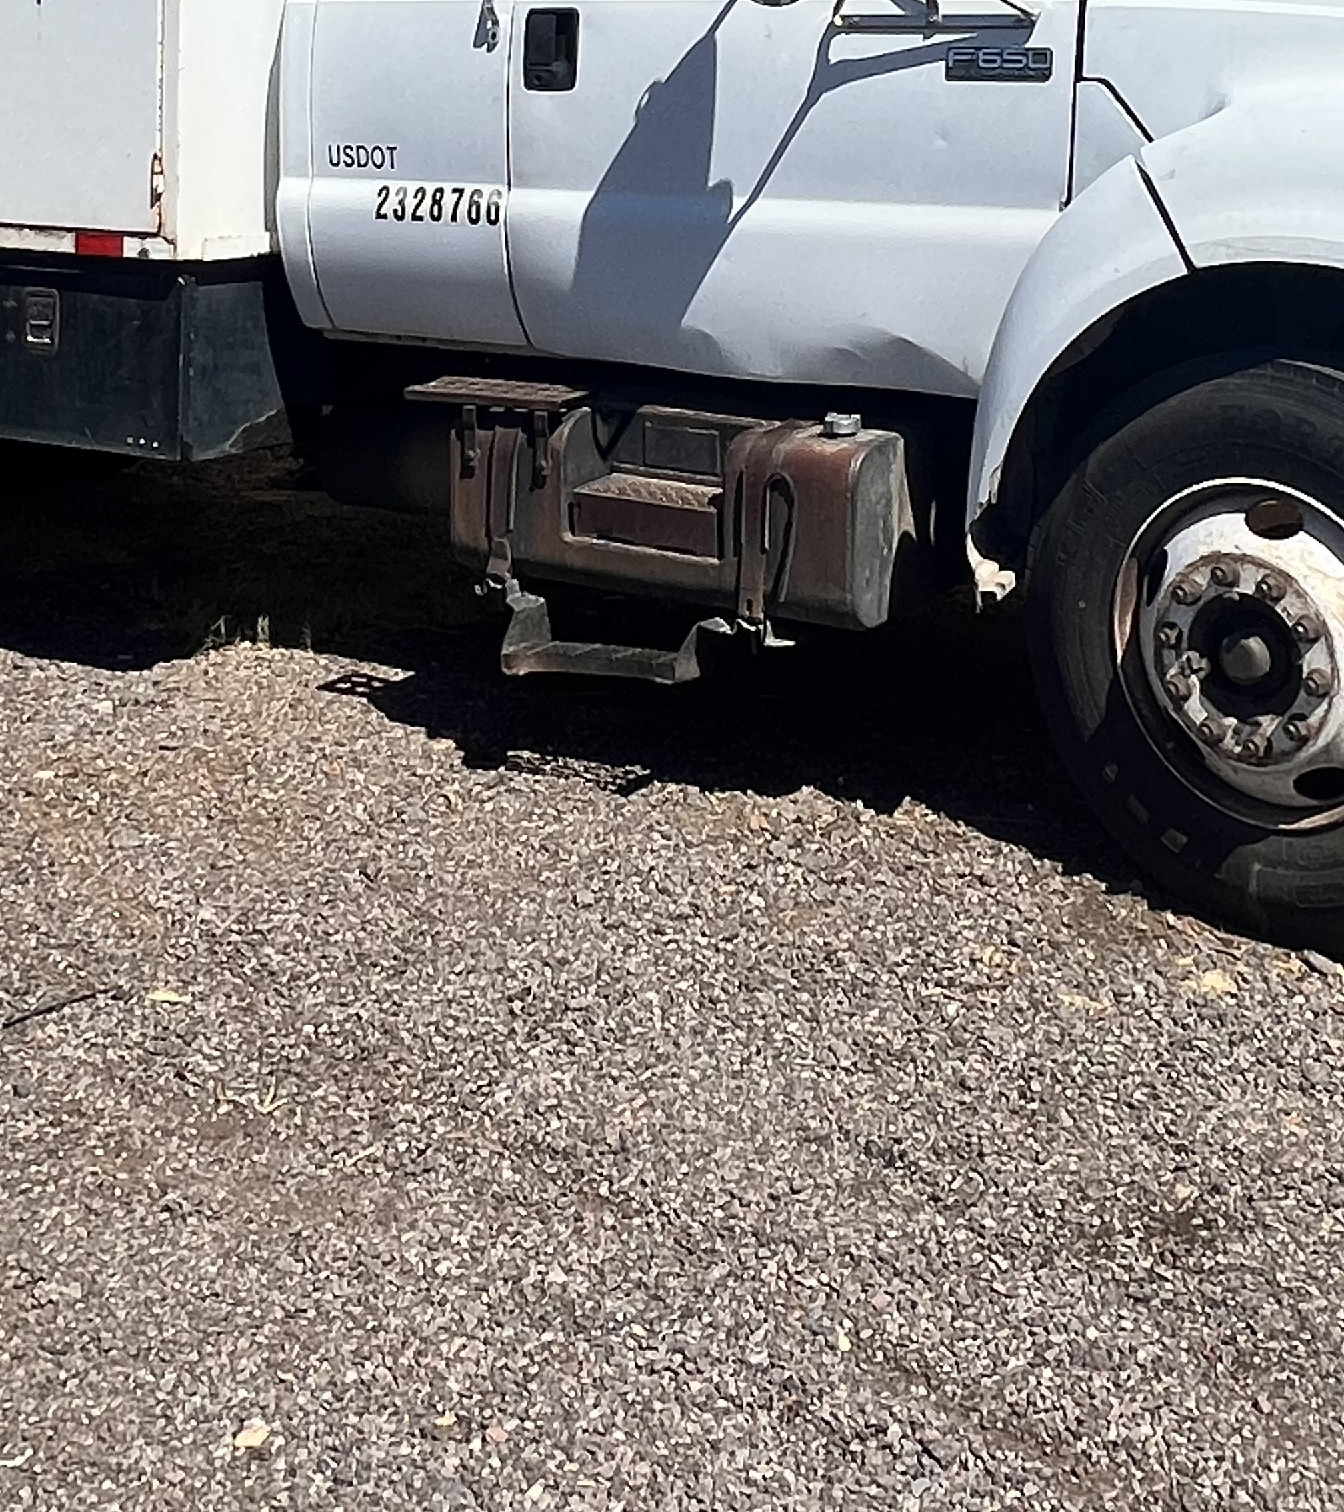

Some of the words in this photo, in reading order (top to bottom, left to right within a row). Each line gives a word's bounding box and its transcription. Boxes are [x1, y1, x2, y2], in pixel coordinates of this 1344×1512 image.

[948, 48, 1050, 68] F650
[328, 145, 397, 169] USDOT
[375, 185, 501, 225] 2328766
